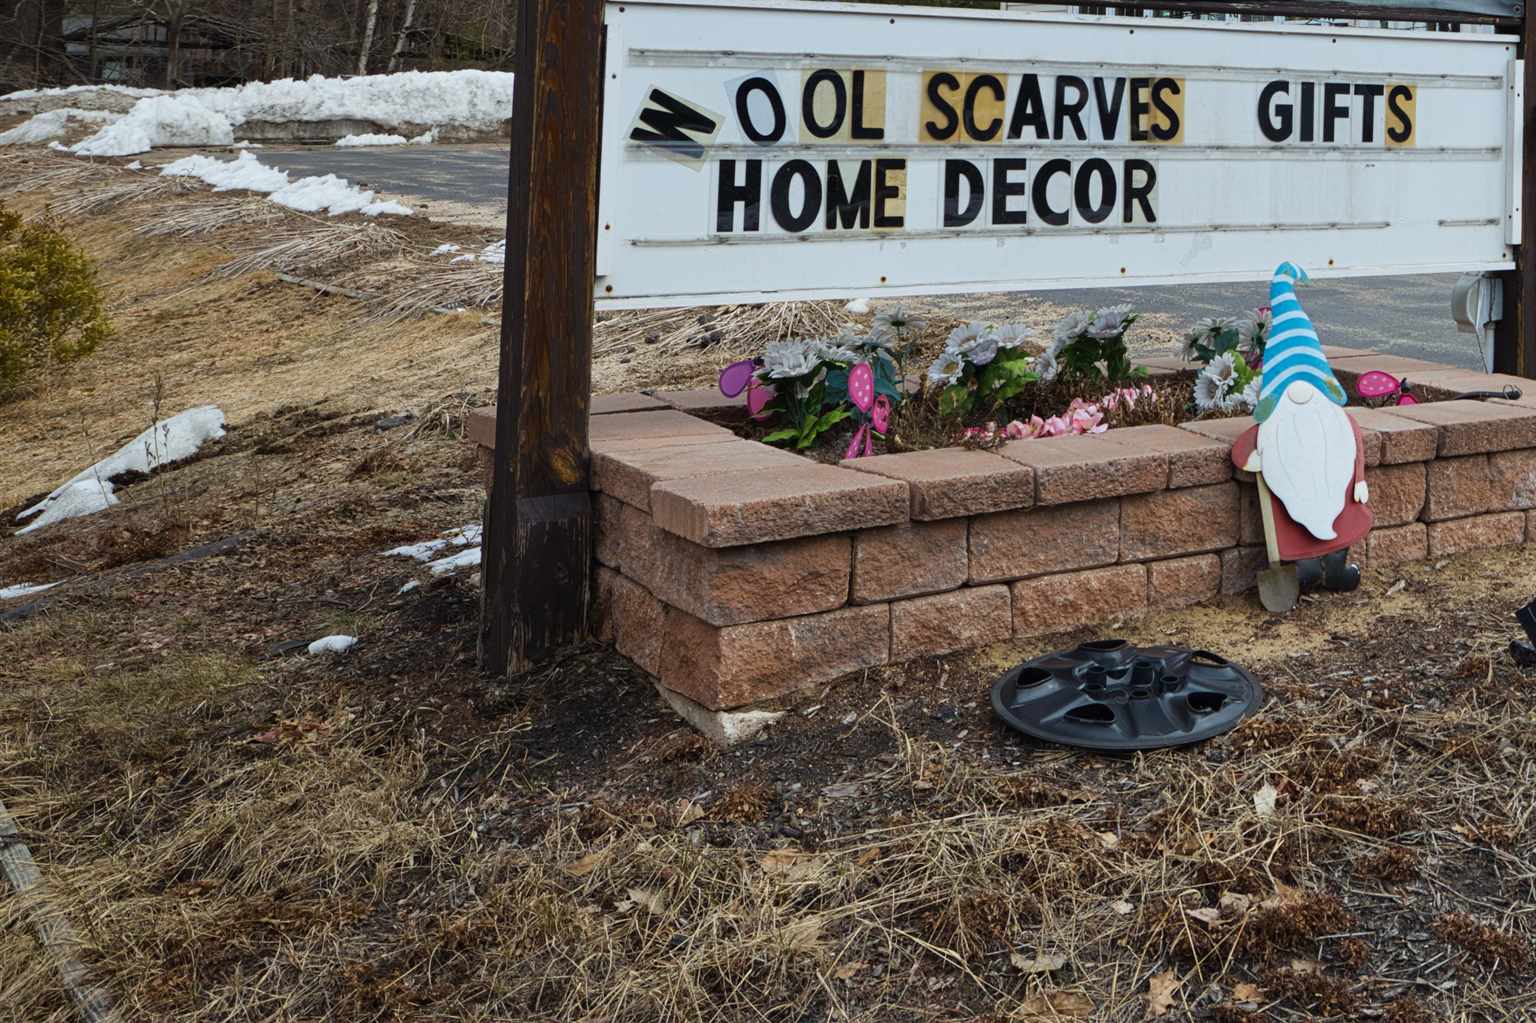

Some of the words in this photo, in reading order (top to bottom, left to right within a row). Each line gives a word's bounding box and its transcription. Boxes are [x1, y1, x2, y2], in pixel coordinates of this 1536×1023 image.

[924, 70, 1183, 142] SCARVES
[1257, 80, 1413, 143] GIFTS
[716, 158, 907, 233] HOME
[943, 158, 1156, 228] DECOR
